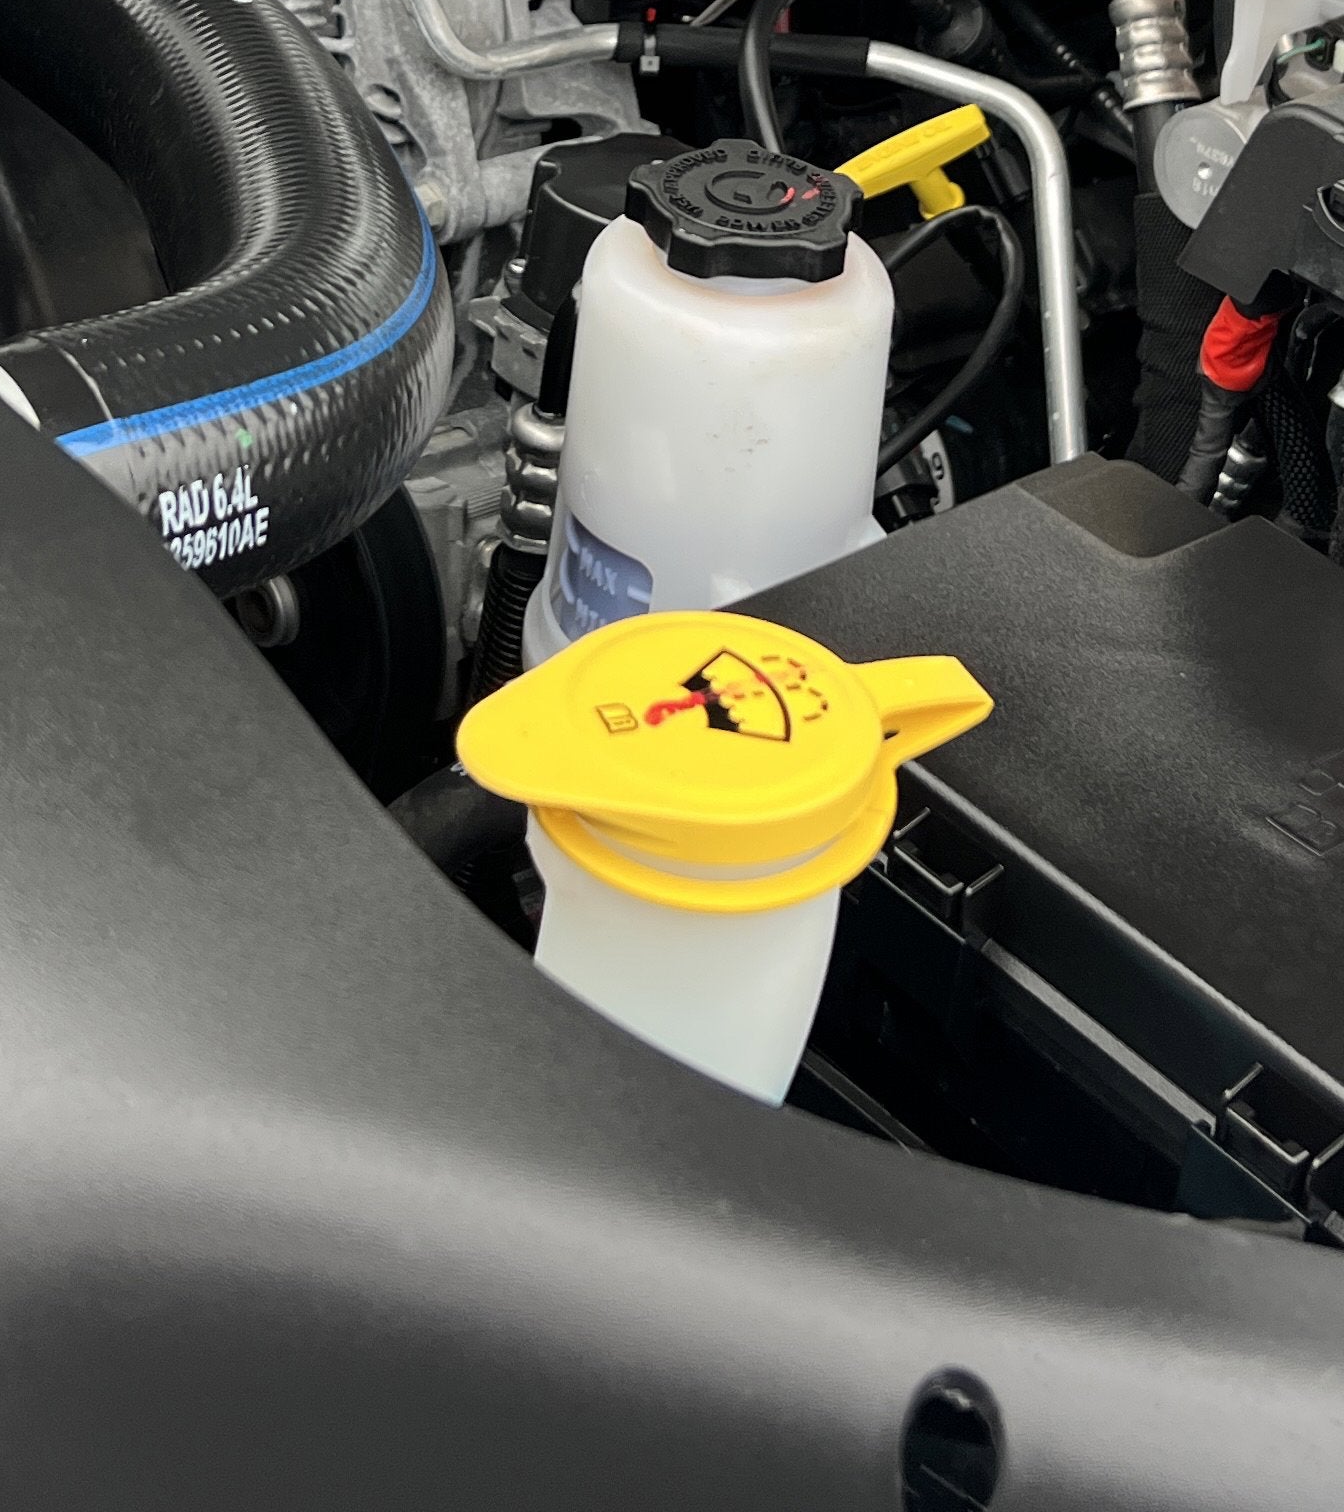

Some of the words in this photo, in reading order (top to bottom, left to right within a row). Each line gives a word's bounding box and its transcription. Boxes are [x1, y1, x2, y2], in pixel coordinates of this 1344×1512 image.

[663, 148, 728, 197] APPROVED
[158, 478, 210, 537] RAD
[212, 464, 259, 521] 6.4L
[580, 546, 619, 596] MAX
[575, 597, 606, 632] MI
